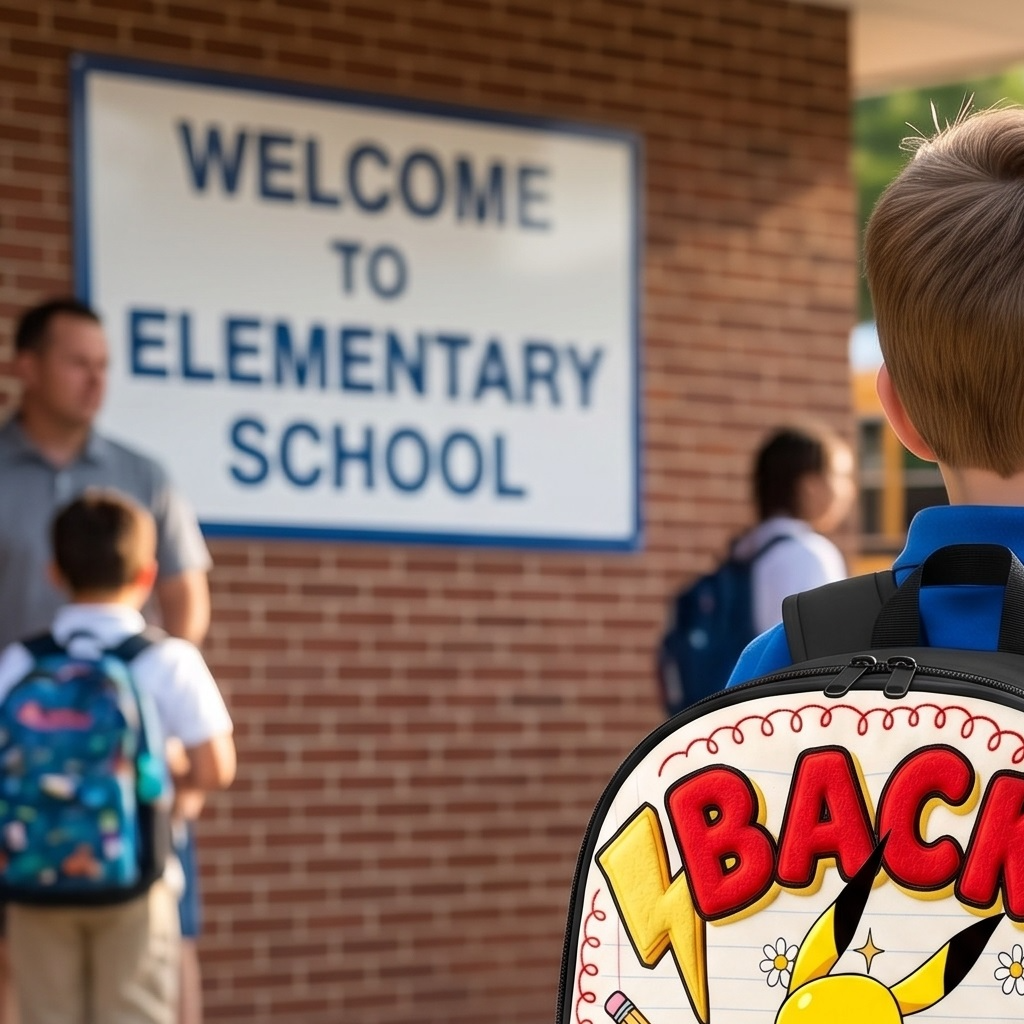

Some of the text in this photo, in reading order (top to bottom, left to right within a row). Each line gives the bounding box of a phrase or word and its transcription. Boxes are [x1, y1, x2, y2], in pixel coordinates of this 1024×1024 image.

[176, 117, 554, 233] WELCOME
[330, 239, 409, 300] TO
[126, 307, 605, 408] ELEMENTARY
[228, 416, 528, 499] SCHOOL
